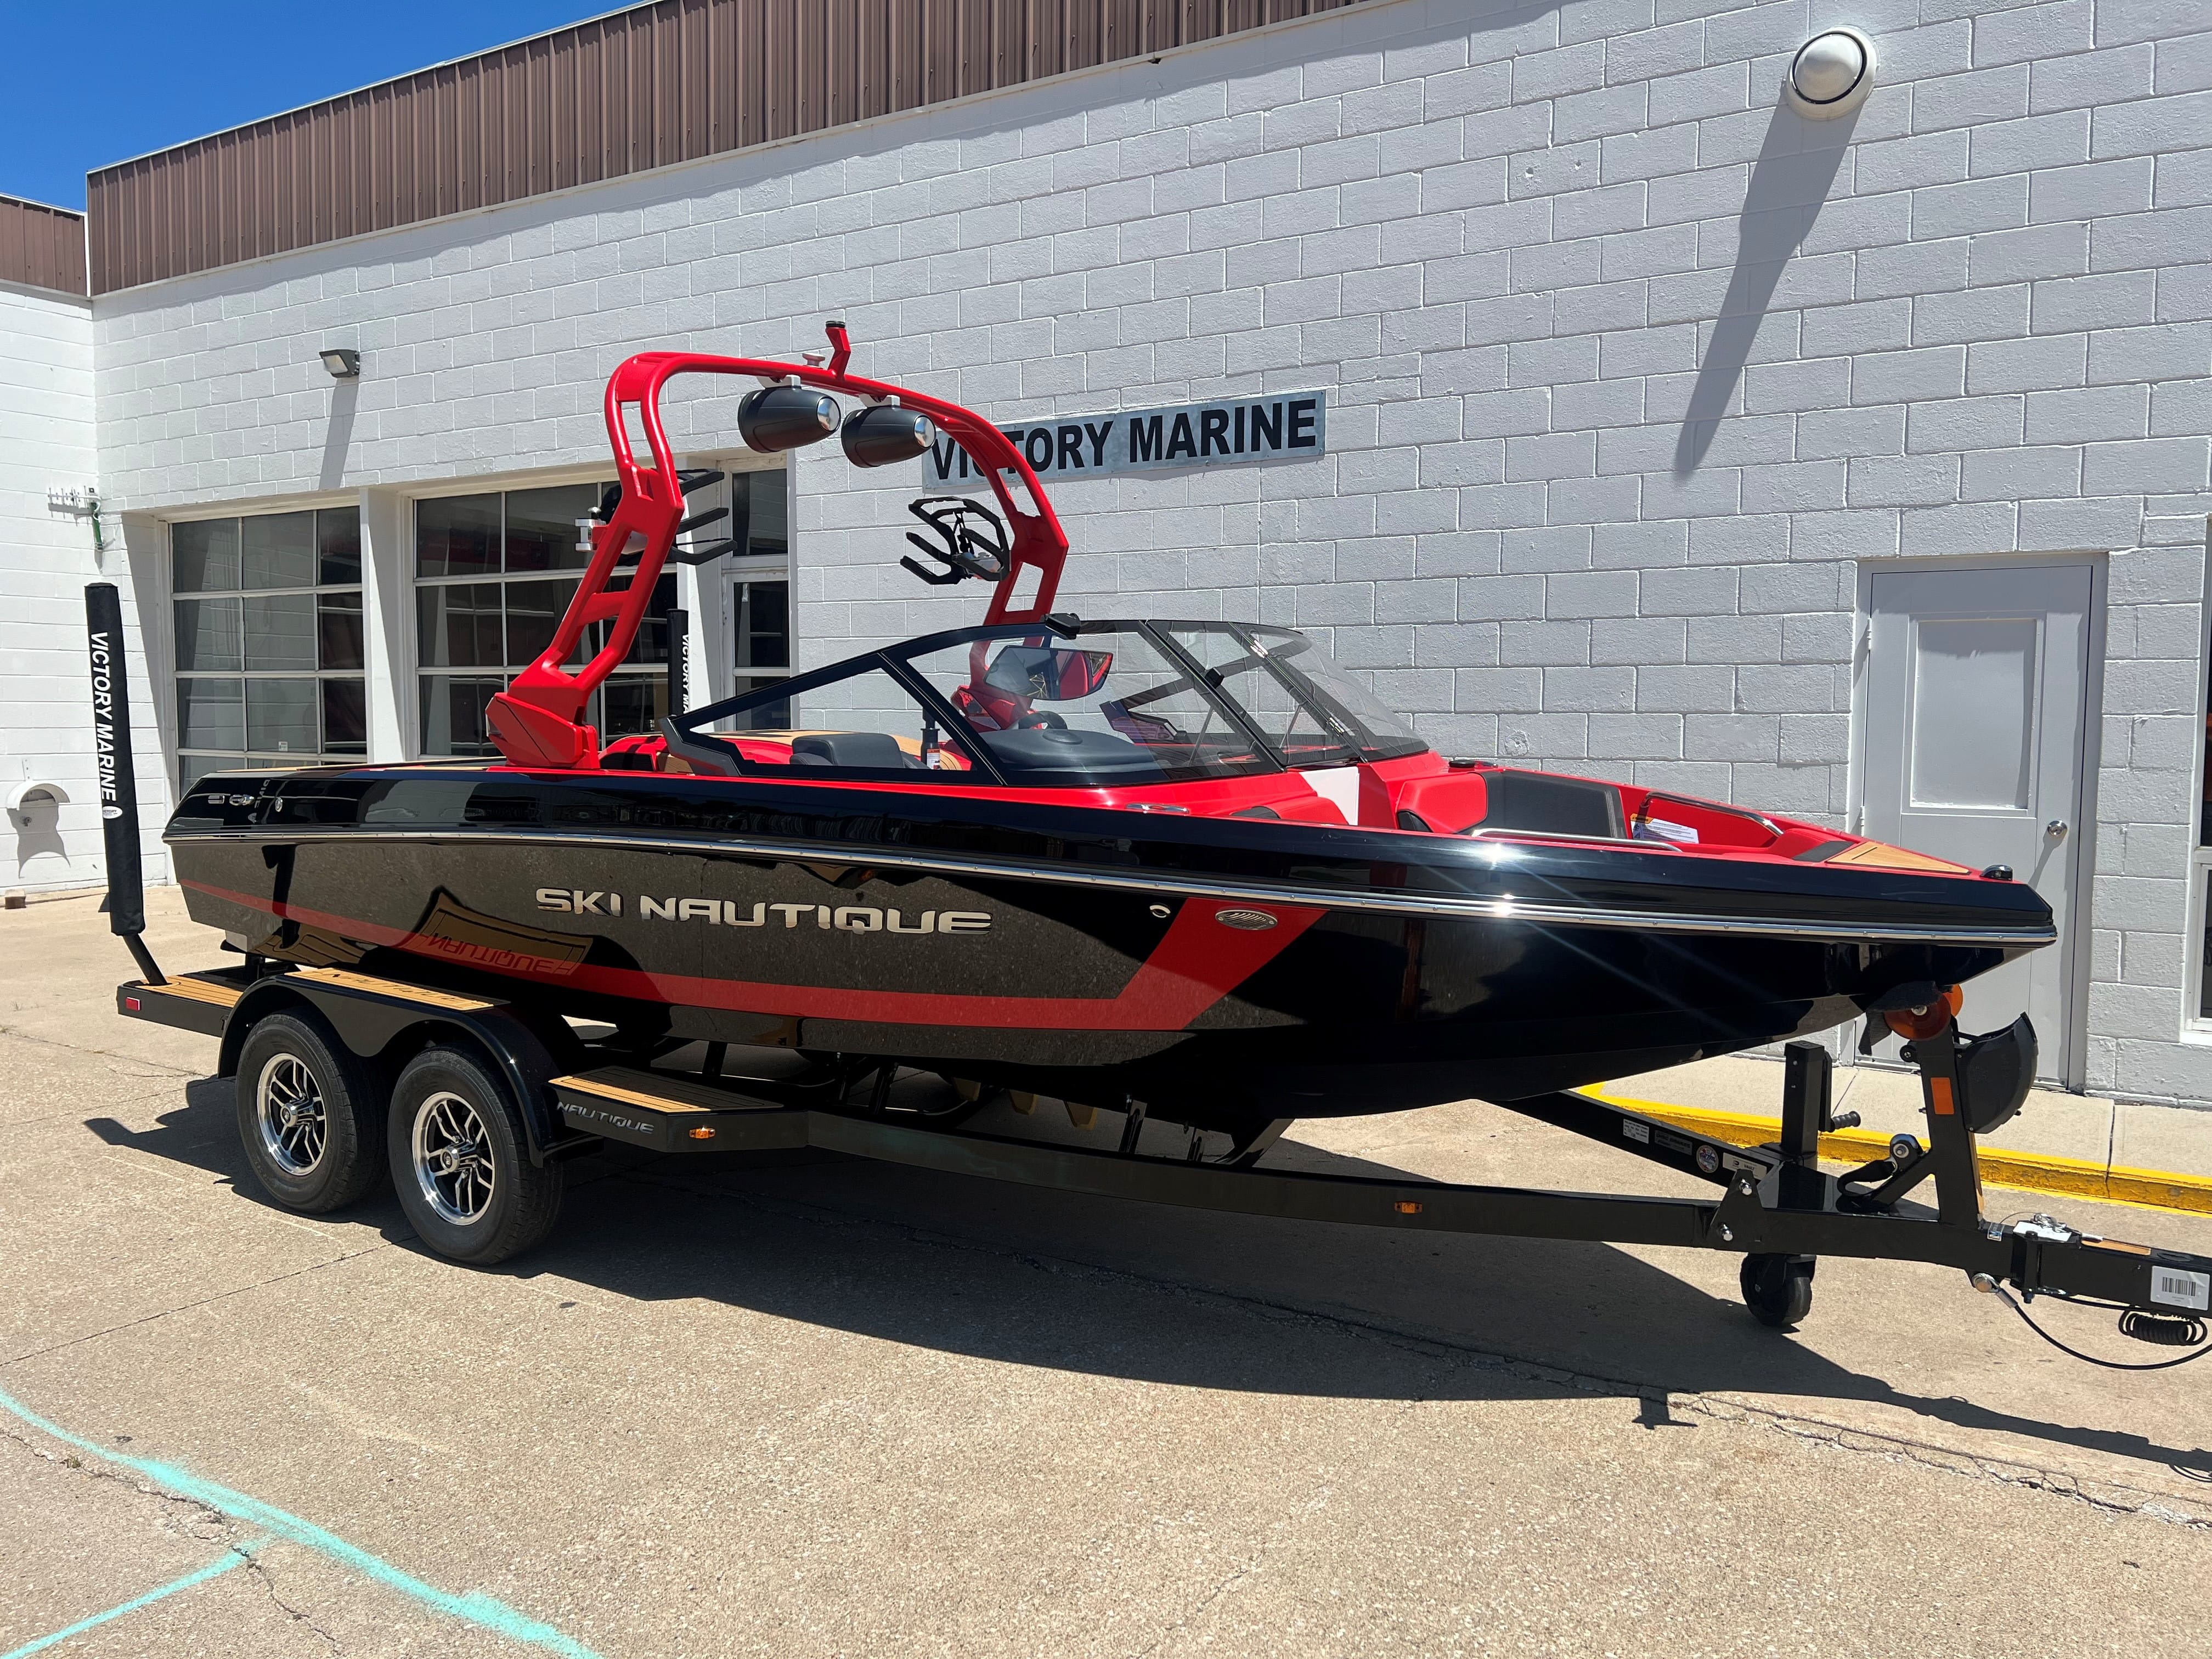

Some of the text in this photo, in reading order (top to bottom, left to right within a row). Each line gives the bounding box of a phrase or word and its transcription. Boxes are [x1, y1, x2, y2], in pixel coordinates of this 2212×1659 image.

[932, 399, 1316, 479] VITORY MARINE
[91, 632, 112, 720] VICTORY
[97, 723, 116, 802] MARINE
[536, 888, 992, 935] SKI NAUTIQUE
[557, 1102, 654, 1134] NAUTIQUE
